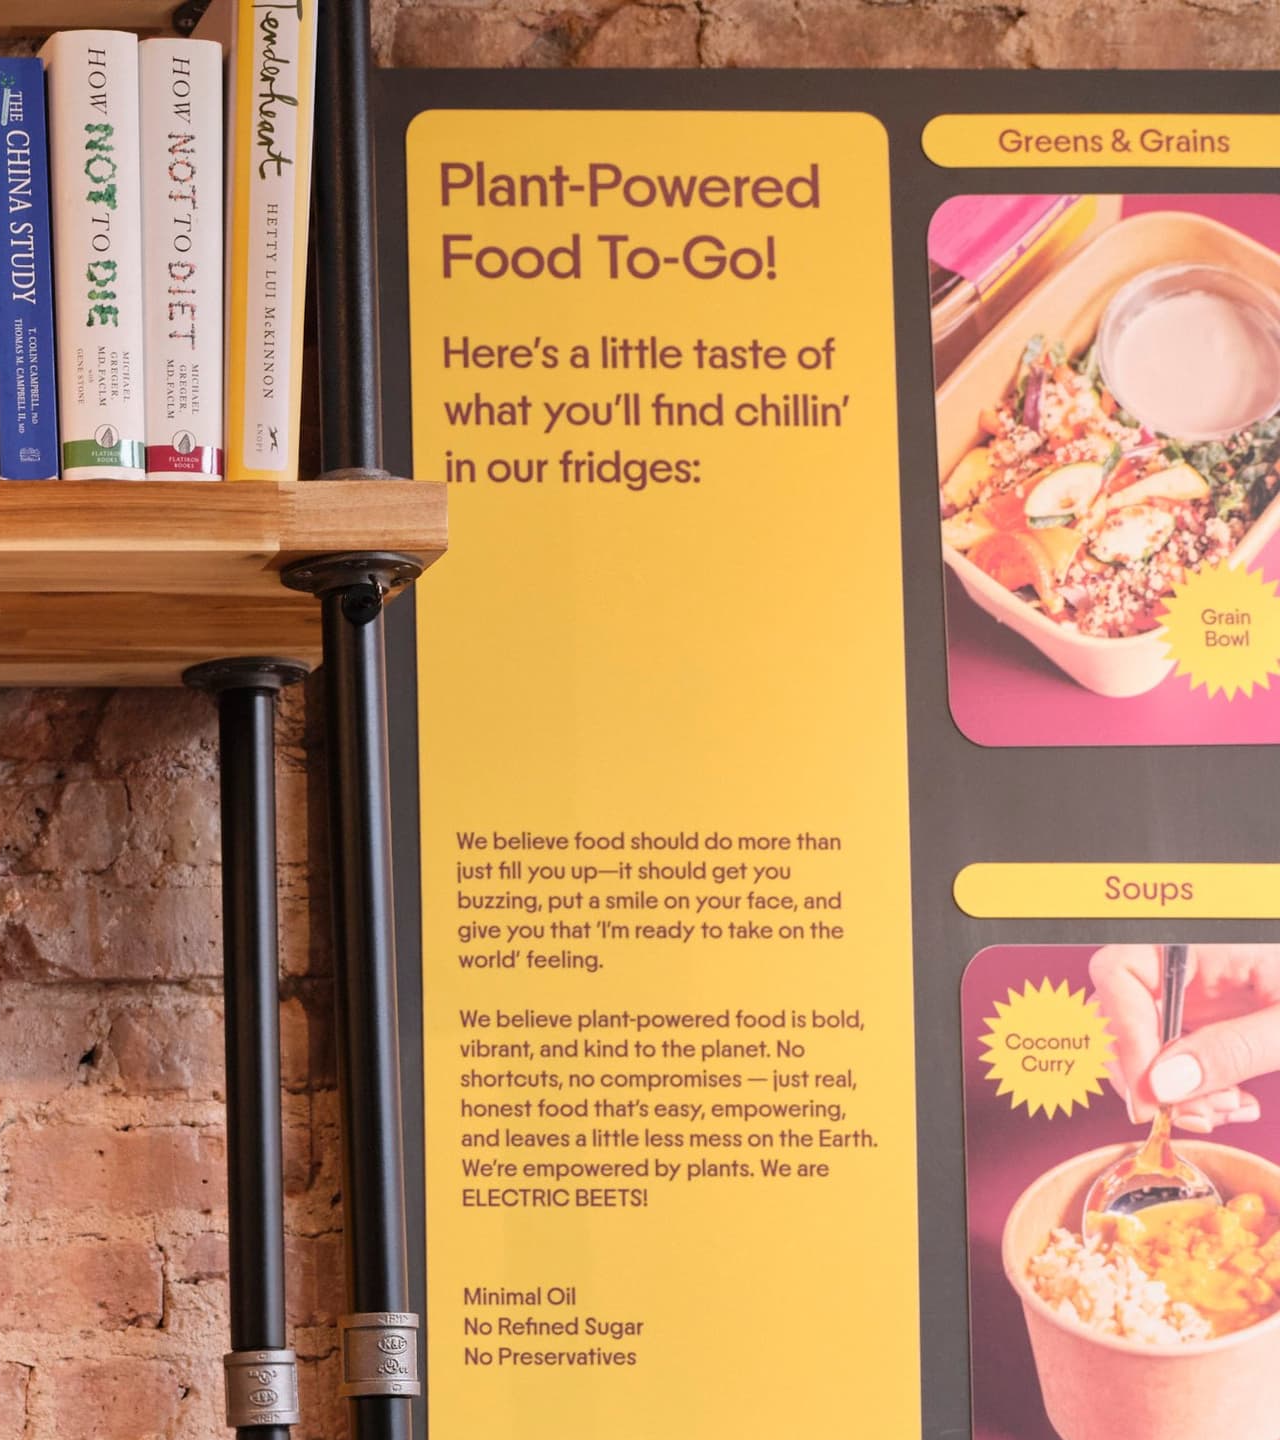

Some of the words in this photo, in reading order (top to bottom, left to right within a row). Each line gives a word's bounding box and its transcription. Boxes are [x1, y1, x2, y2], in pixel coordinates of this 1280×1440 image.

[87, 47, 108, 116] HOW
[172, 55, 191, 125] HOW
[7, 90, 25, 123] THE
[997, 128, 1104, 154] Greens
[1139, 127, 1231, 154] Grains
[5, 129, 33, 214] CHINA
[84, 123, 118, 210] NOT
[167, 130, 198, 211] NOT
[439, 160, 821, 210] Plant-Powered
[90, 212, 111, 253] TO
[172, 212, 193, 253] TO
[266, 203, 279, 262] HETTY
[8, 222, 37, 306] STUDY
[441, 232, 582, 280] Food
[596, 233, 778, 281] To-Go!
[86, 259, 119, 329] DIE
[265, 269, 278, 302] LUI
[167, 260, 197, 351] DIET
[263, 306, 277, 400] McKINNON
[442, 335, 560, 370] Here's
[569, 344, 590, 370] a
[600, 335, 684, 371] little
[692, 338, 788, 371] taste
[796, 336, 837, 371] of
[443, 391, 533, 427] what
[543, 392, 641, 435] you'll
[650, 392, 725, 427] find
[734, 392, 850, 428] chillin'
[444, 449, 477, 484] in
[486, 458, 550, 484] our
[558, 449, 702, 493] fridges:
[1200, 608, 1252, 626] Grain
[1204, 629, 1250, 648] Bowl
[455, 831, 489, 851] We
[492, 830, 570, 851] believe
[573, 831, 626, 851] food
[630, 831, 700, 851] should
[703, 831, 734, 851] do
[737, 836, 792, 851] more
[795, 831, 842, 851] than
[456, 860, 494, 885] just
[497, 860, 522, 881] fill
[527, 865, 566, 885] you
[637, 860, 707, 881] should
[711, 861, 749, 885] get
[752, 865, 792, 885] you
[457, 889, 543, 914] buzzing,
[547, 891, 585, 914] put
[587, 895, 601, 910] a
[605, 889, 660, 910] smile
[663, 895, 691, 910] on
[695, 895, 743, 914] your
[745, 890, 799, 913] face,
[803, 890, 842, 911] and
[1104, 874, 1195, 908] Soups
[457, 920, 502, 944] give
[505, 924, 546, 944] you
[549, 919, 592, 940] that
[595, 919, 630, 940] 'I'm
[634, 919, 696, 944] ready
[699, 921, 724, 940] to
[727, 919, 774, 940] take
[777, 925, 805, 940] on
[808, 920, 845, 940] the
[457, 949, 521, 969] world'
[525, 949, 604, 974] feeling.
[1004, 1032, 1091, 1051] Coconut
[1020, 1054, 1076, 1076] Curry
[461, 1187, 571, 1208] ELECTRIC
[575, 1187, 649, 1208] BEETS!
[463, 1286, 542, 1306] Minimal
[546, 1286, 577, 1307] Oil
[463, 1316, 494, 1336] No
[497, 1315, 580, 1337] Refined
[584, 1316, 645, 1341] Sugar
[464, 1346, 494, 1366] No
[497, 1346, 637, 1367] Preservatives
